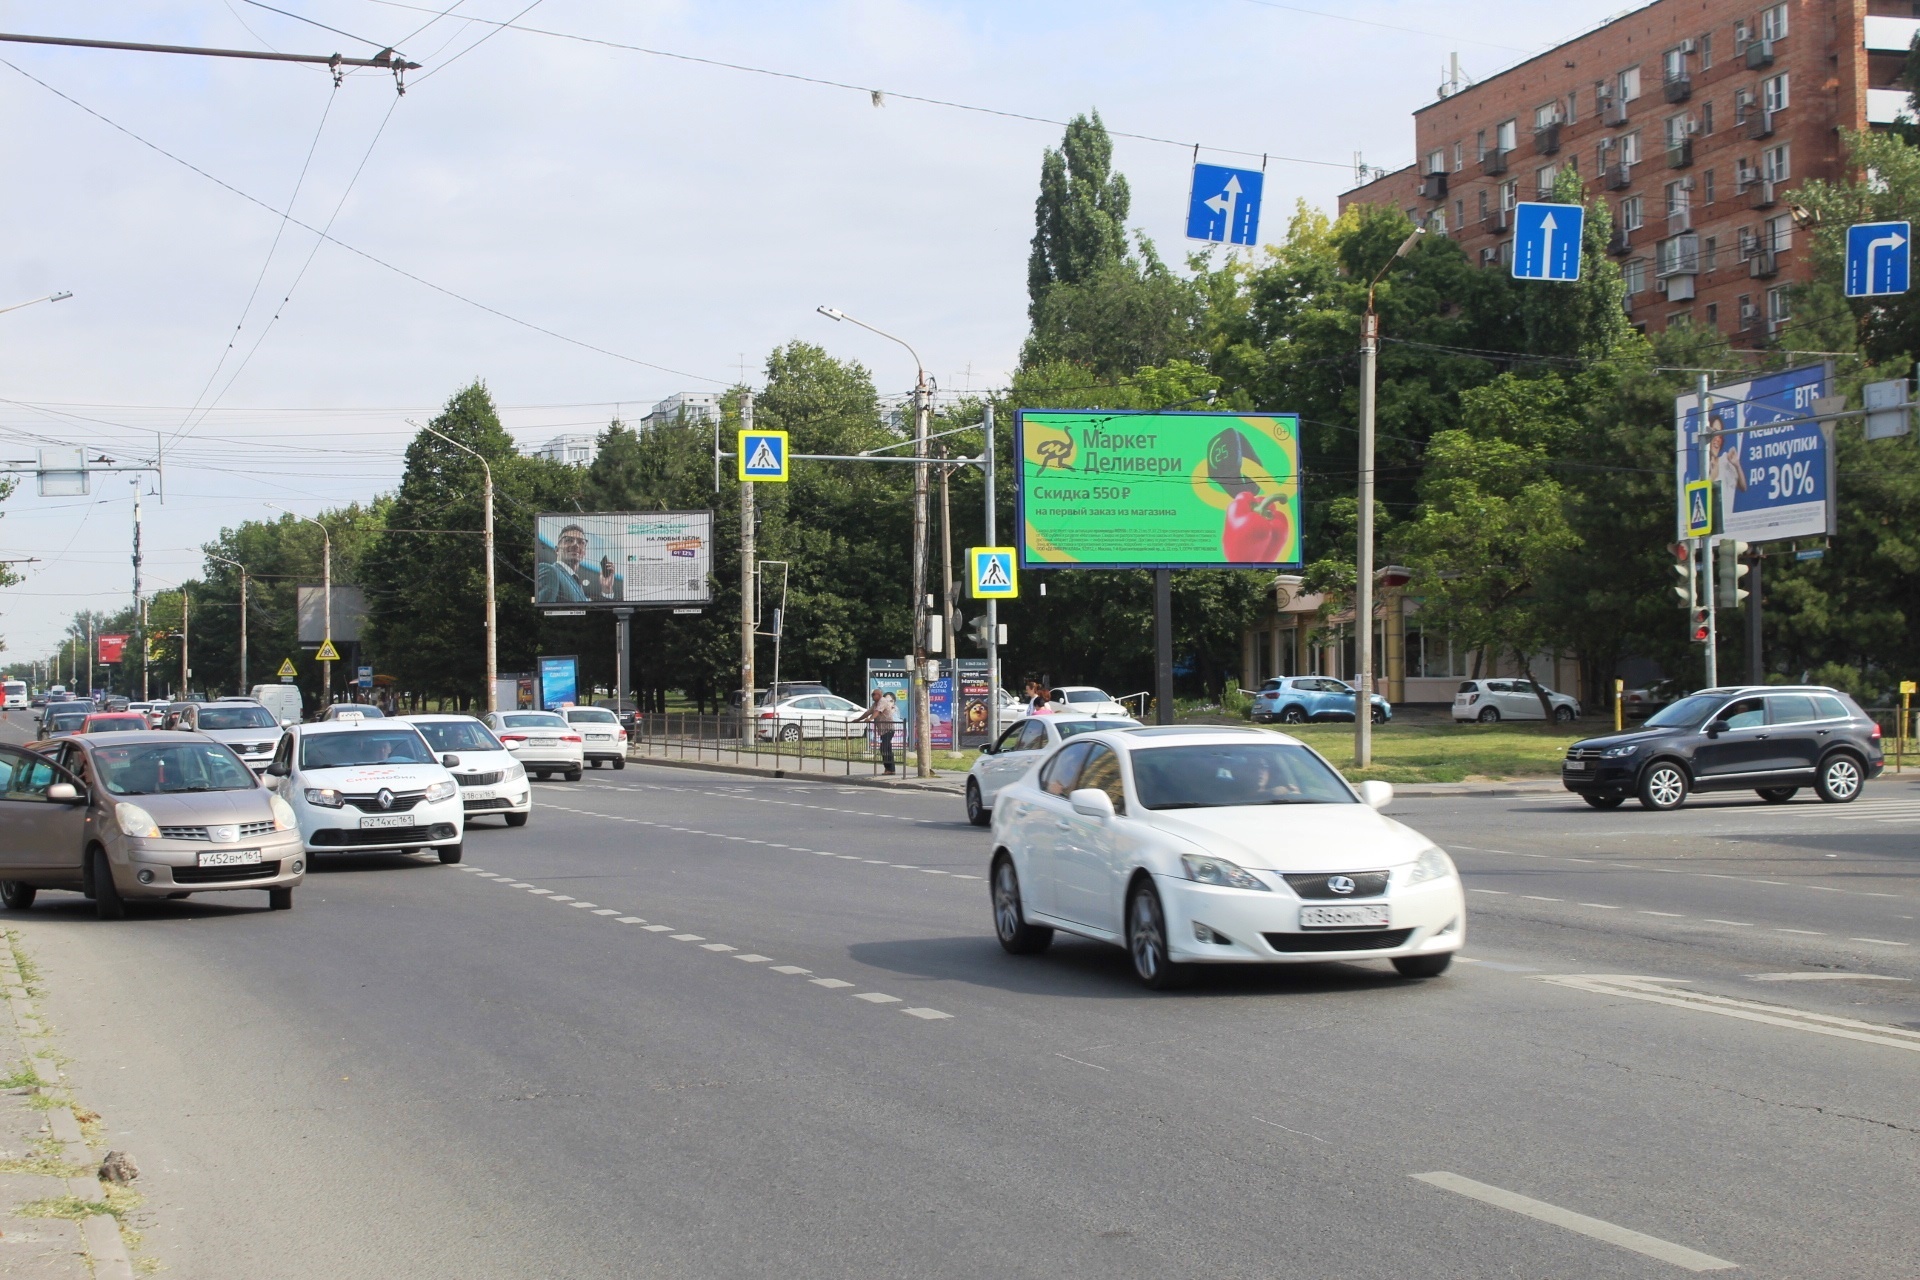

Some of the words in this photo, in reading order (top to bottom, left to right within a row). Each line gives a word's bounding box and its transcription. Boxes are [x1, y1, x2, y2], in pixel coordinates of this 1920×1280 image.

[1794, 383, 1820, 409] ВТБ
[1082, 428, 1157, 452] Маркет
[1276, 427, 1288, 436] 0+
[1749, 445, 1763, 461] за
[1764, 435, 1818, 460] покупки
[1083, 451, 1182, 476] Деливери
[1749, 466, 1765, 486] до
[1767, 460, 1815, 500] 30%
[1033, 486, 1090, 502] Скидка
[1035, 508, 1048, 516] на
[1049, 506, 1088, 517] первый
[1088, 508, 1116, 516] заказ
[1117, 508, 1129, 516] из
[1130, 508, 1177, 516] магазина
[345, 775, 417, 783] Ситимобил
[203, 853, 242, 865] У452ВМ
[243, 851, 258, 860] 161
